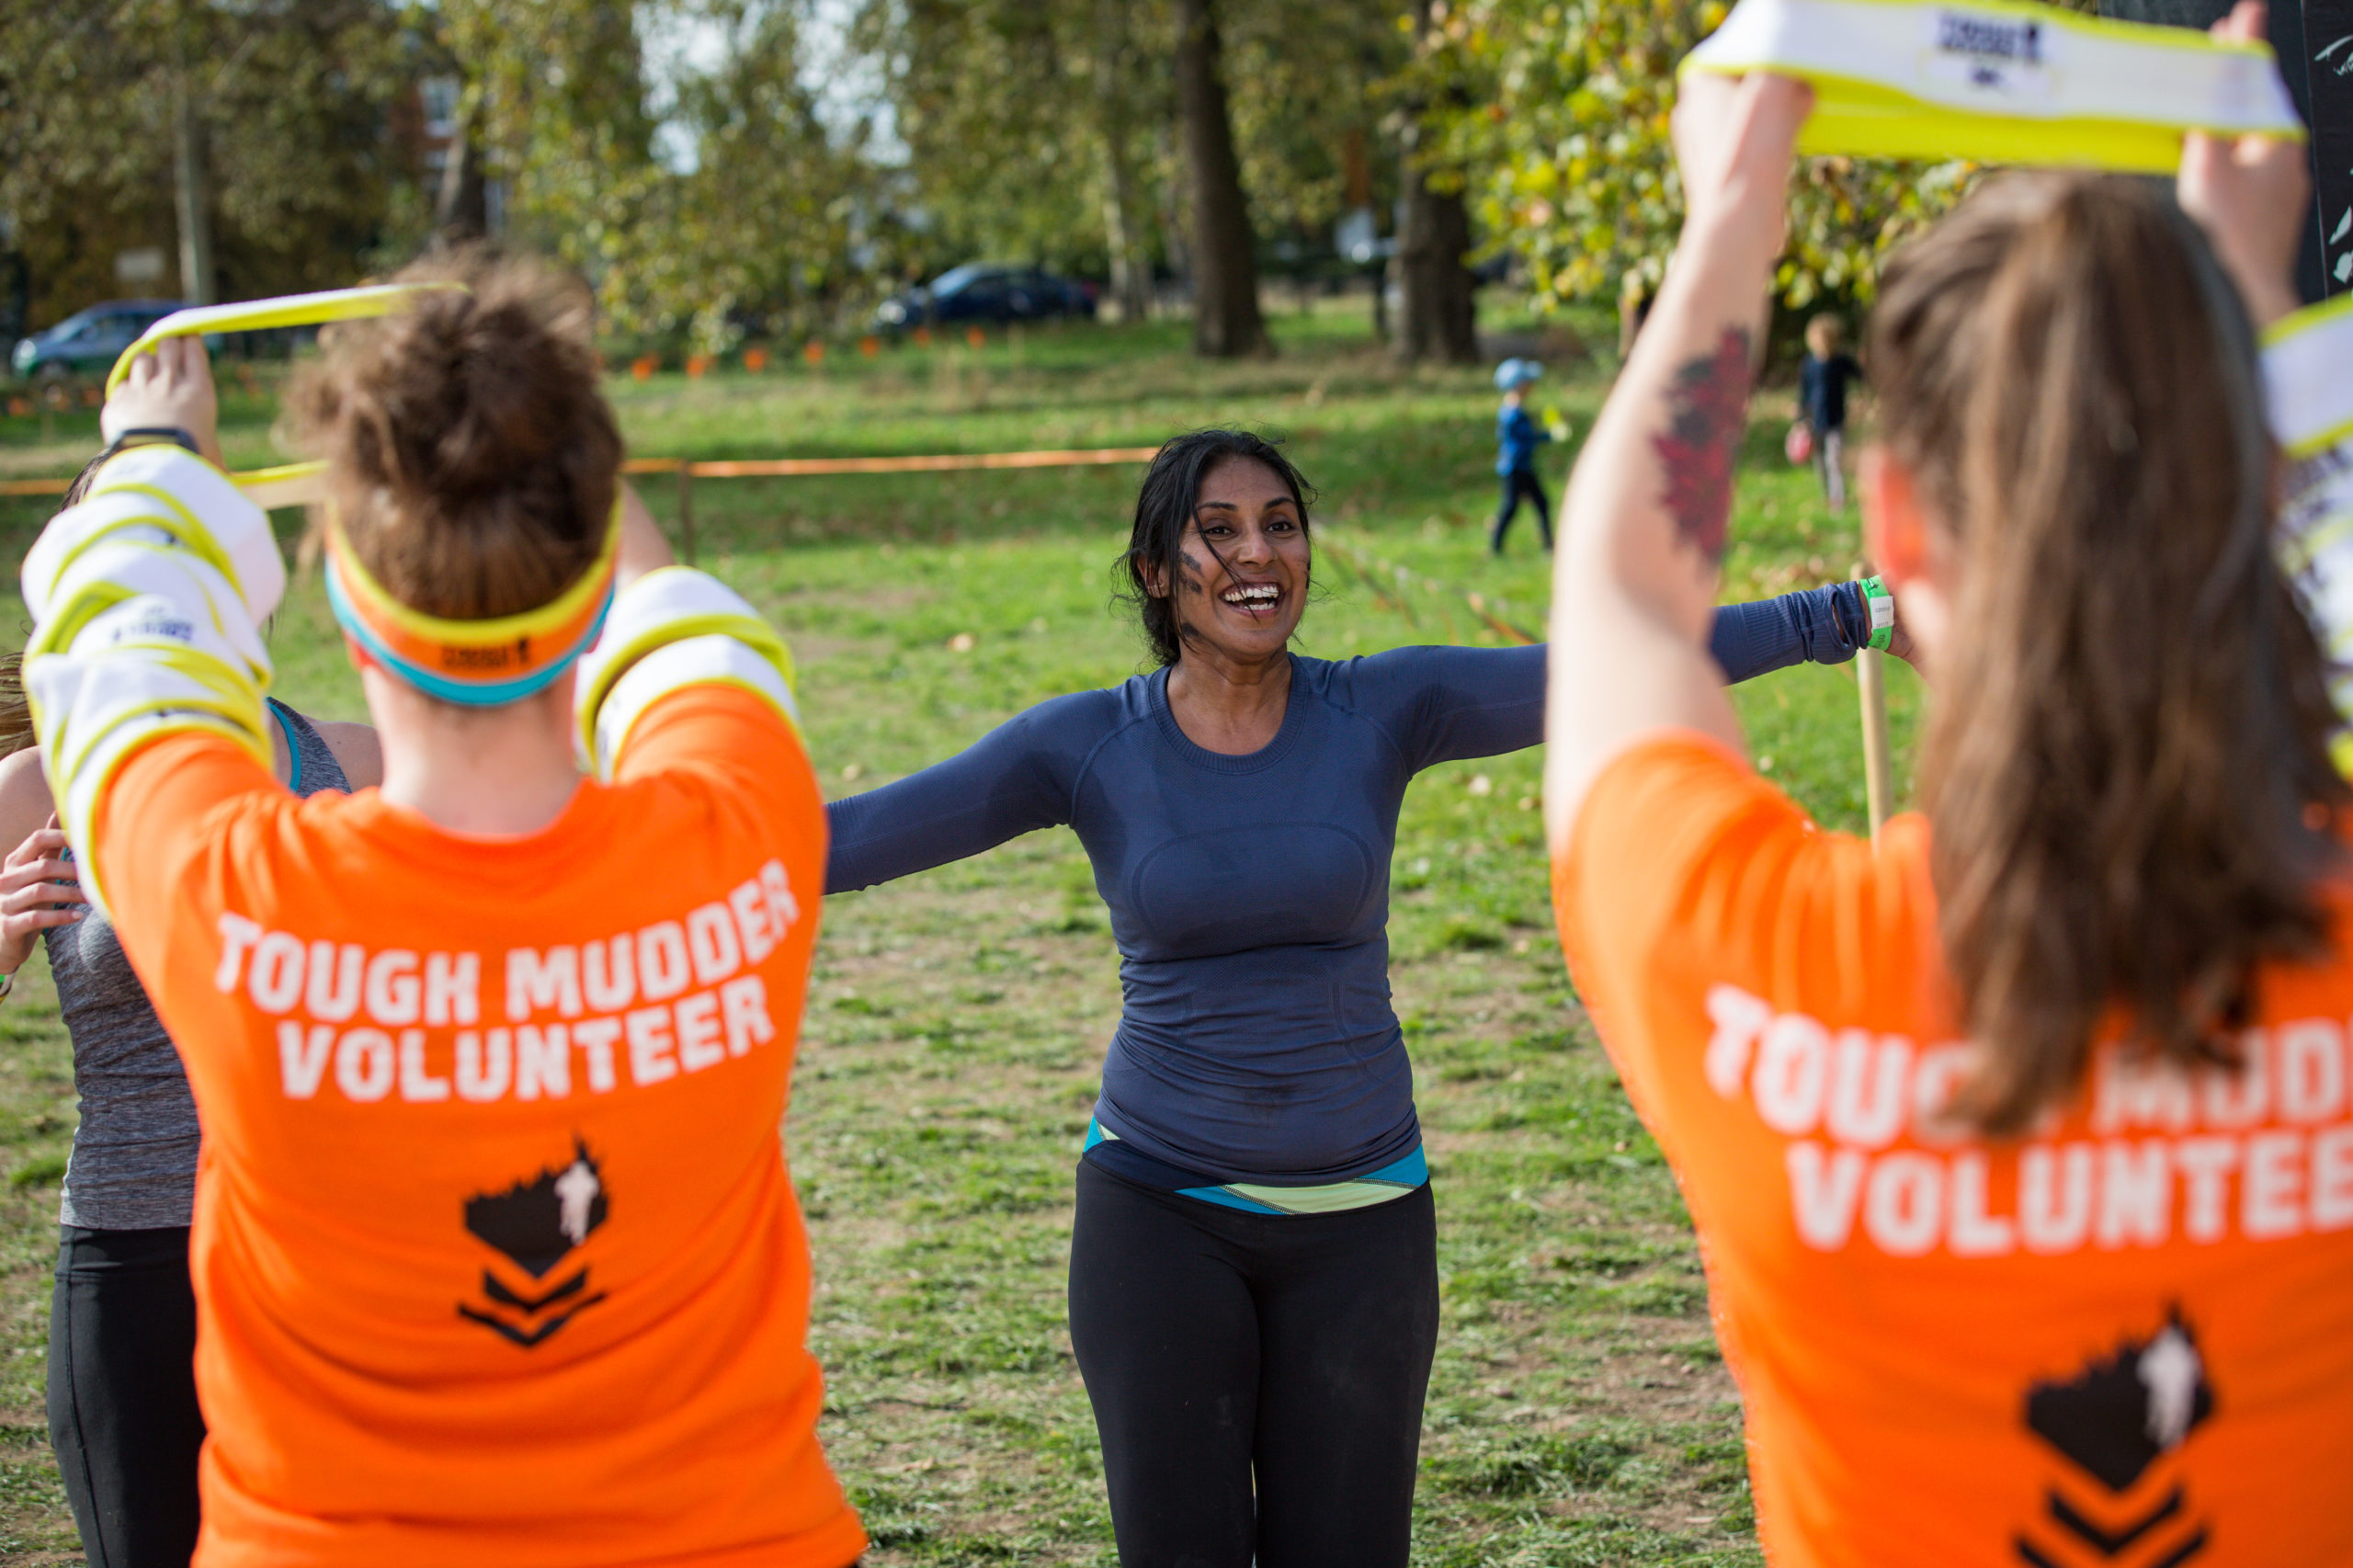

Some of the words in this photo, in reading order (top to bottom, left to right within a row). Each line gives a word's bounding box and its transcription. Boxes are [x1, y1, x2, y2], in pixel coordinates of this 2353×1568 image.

[215, 911, 480, 1027] TOUGH
[505, 858, 801, 1022] MUDDER
[277, 975, 775, 1103] VOLUNTEER
